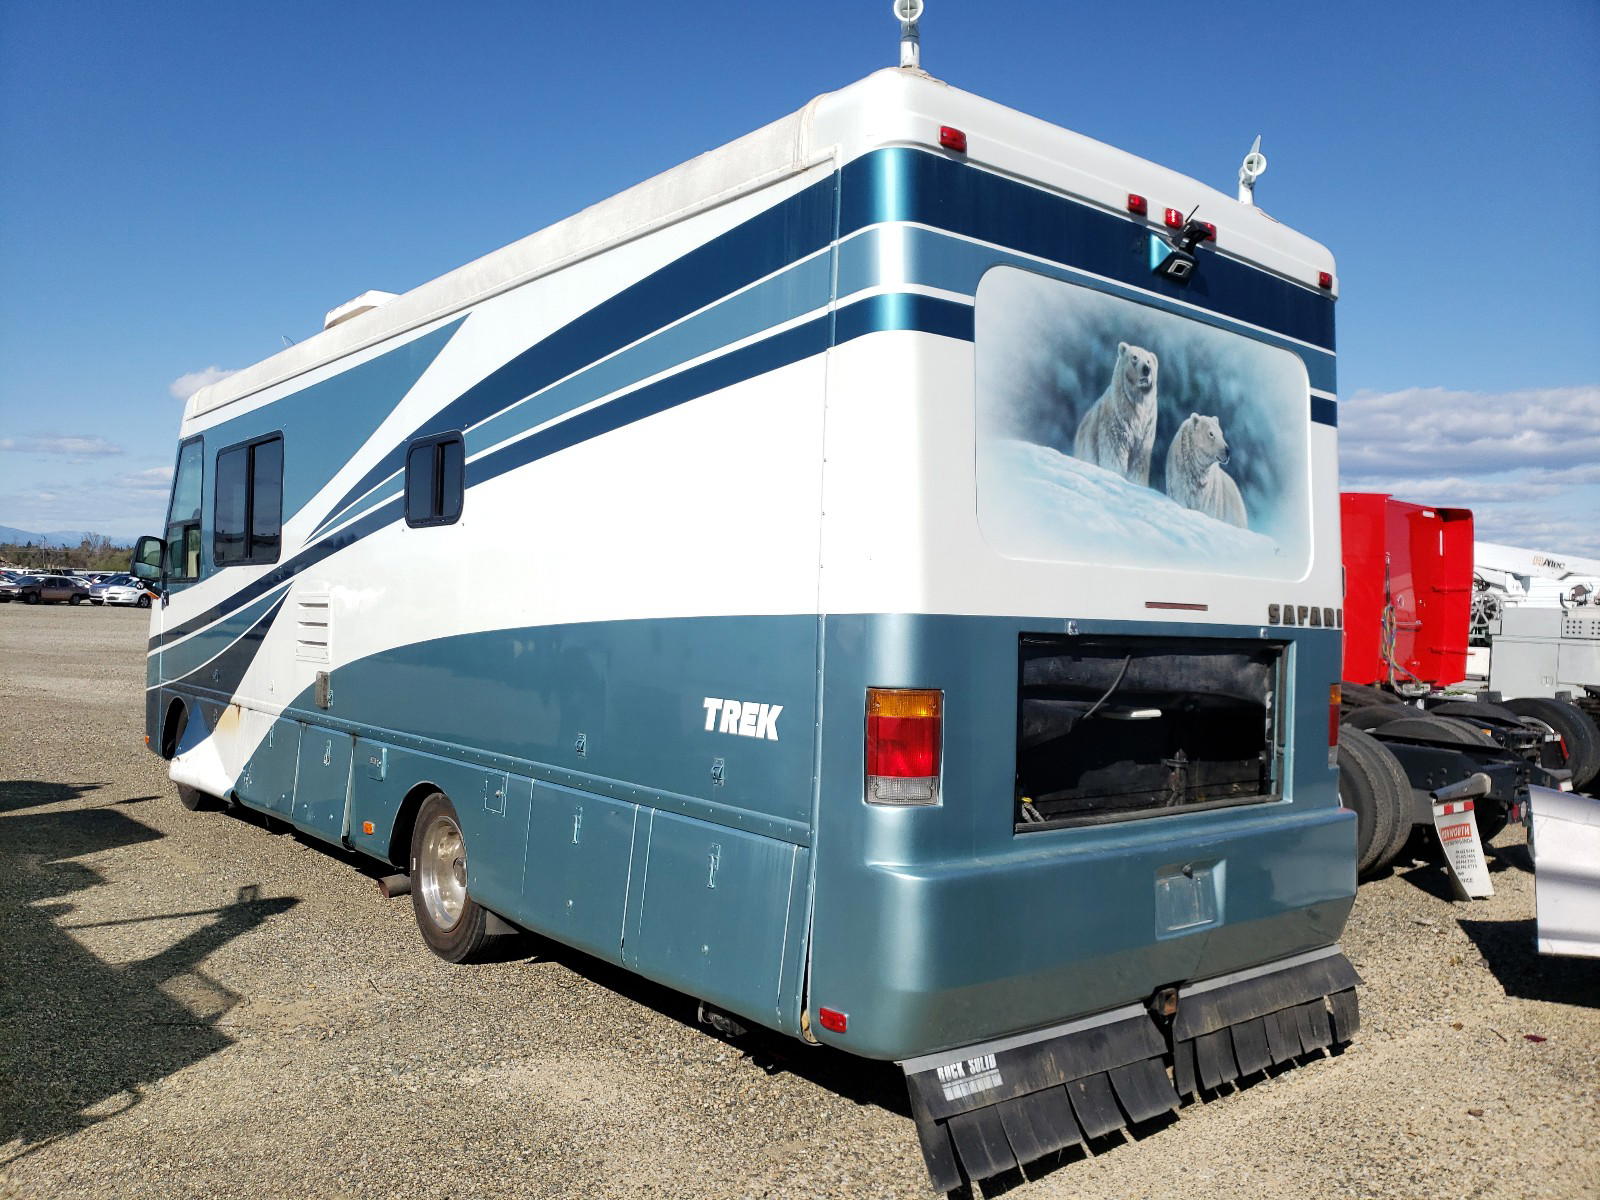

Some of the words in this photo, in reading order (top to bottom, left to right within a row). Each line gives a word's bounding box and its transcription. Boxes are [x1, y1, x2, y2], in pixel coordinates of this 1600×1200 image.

[1268, 603, 1343, 629] SAFARI
[703, 697, 784, 741] TREK
[937, 1061, 966, 1083] ROCK
[967, 1053, 997, 1075] SOLID
